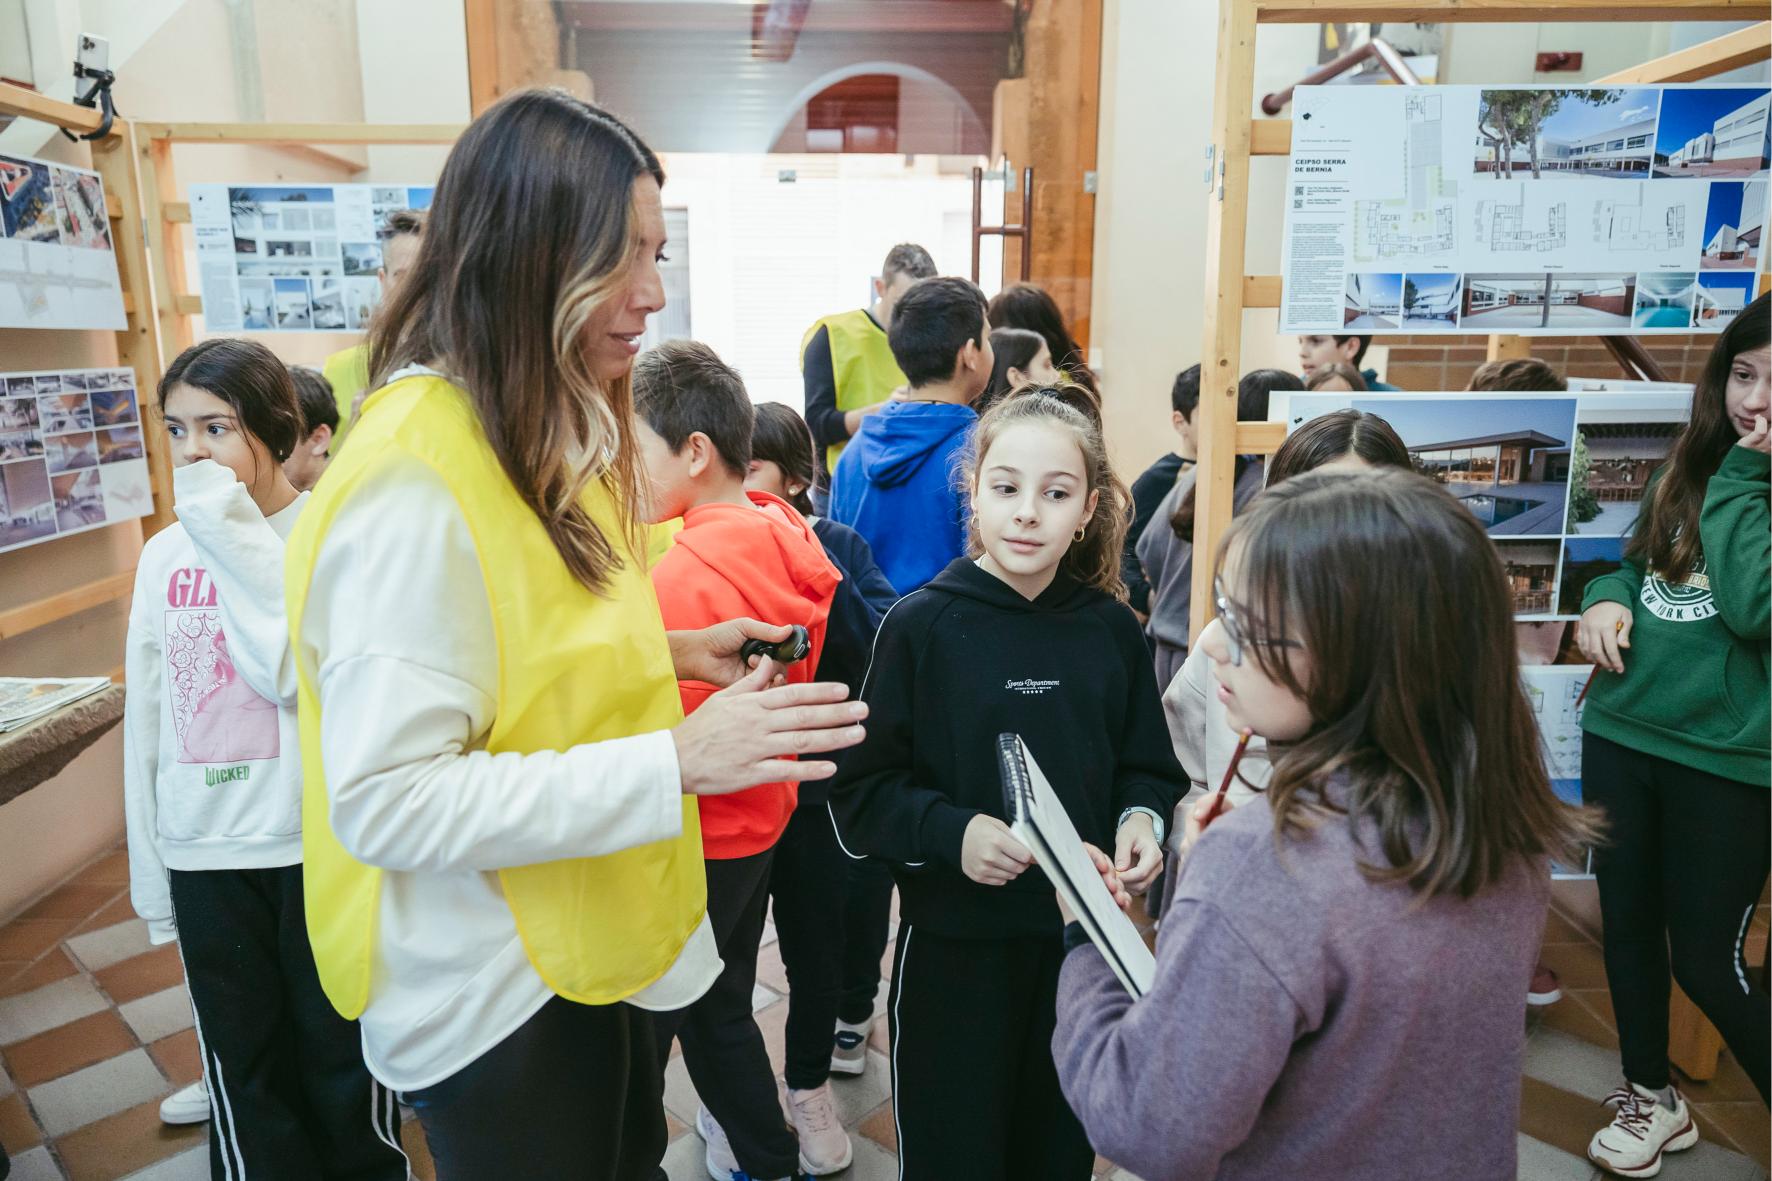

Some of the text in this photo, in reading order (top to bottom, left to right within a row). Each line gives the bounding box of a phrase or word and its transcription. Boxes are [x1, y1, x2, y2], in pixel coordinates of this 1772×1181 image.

[167, 568, 217, 608] GLI
[1642, 580, 1718, 619] NEW YORK CIT
[1025, 679, 1060, 688] Department
[205, 765, 249, 787] WICKED
